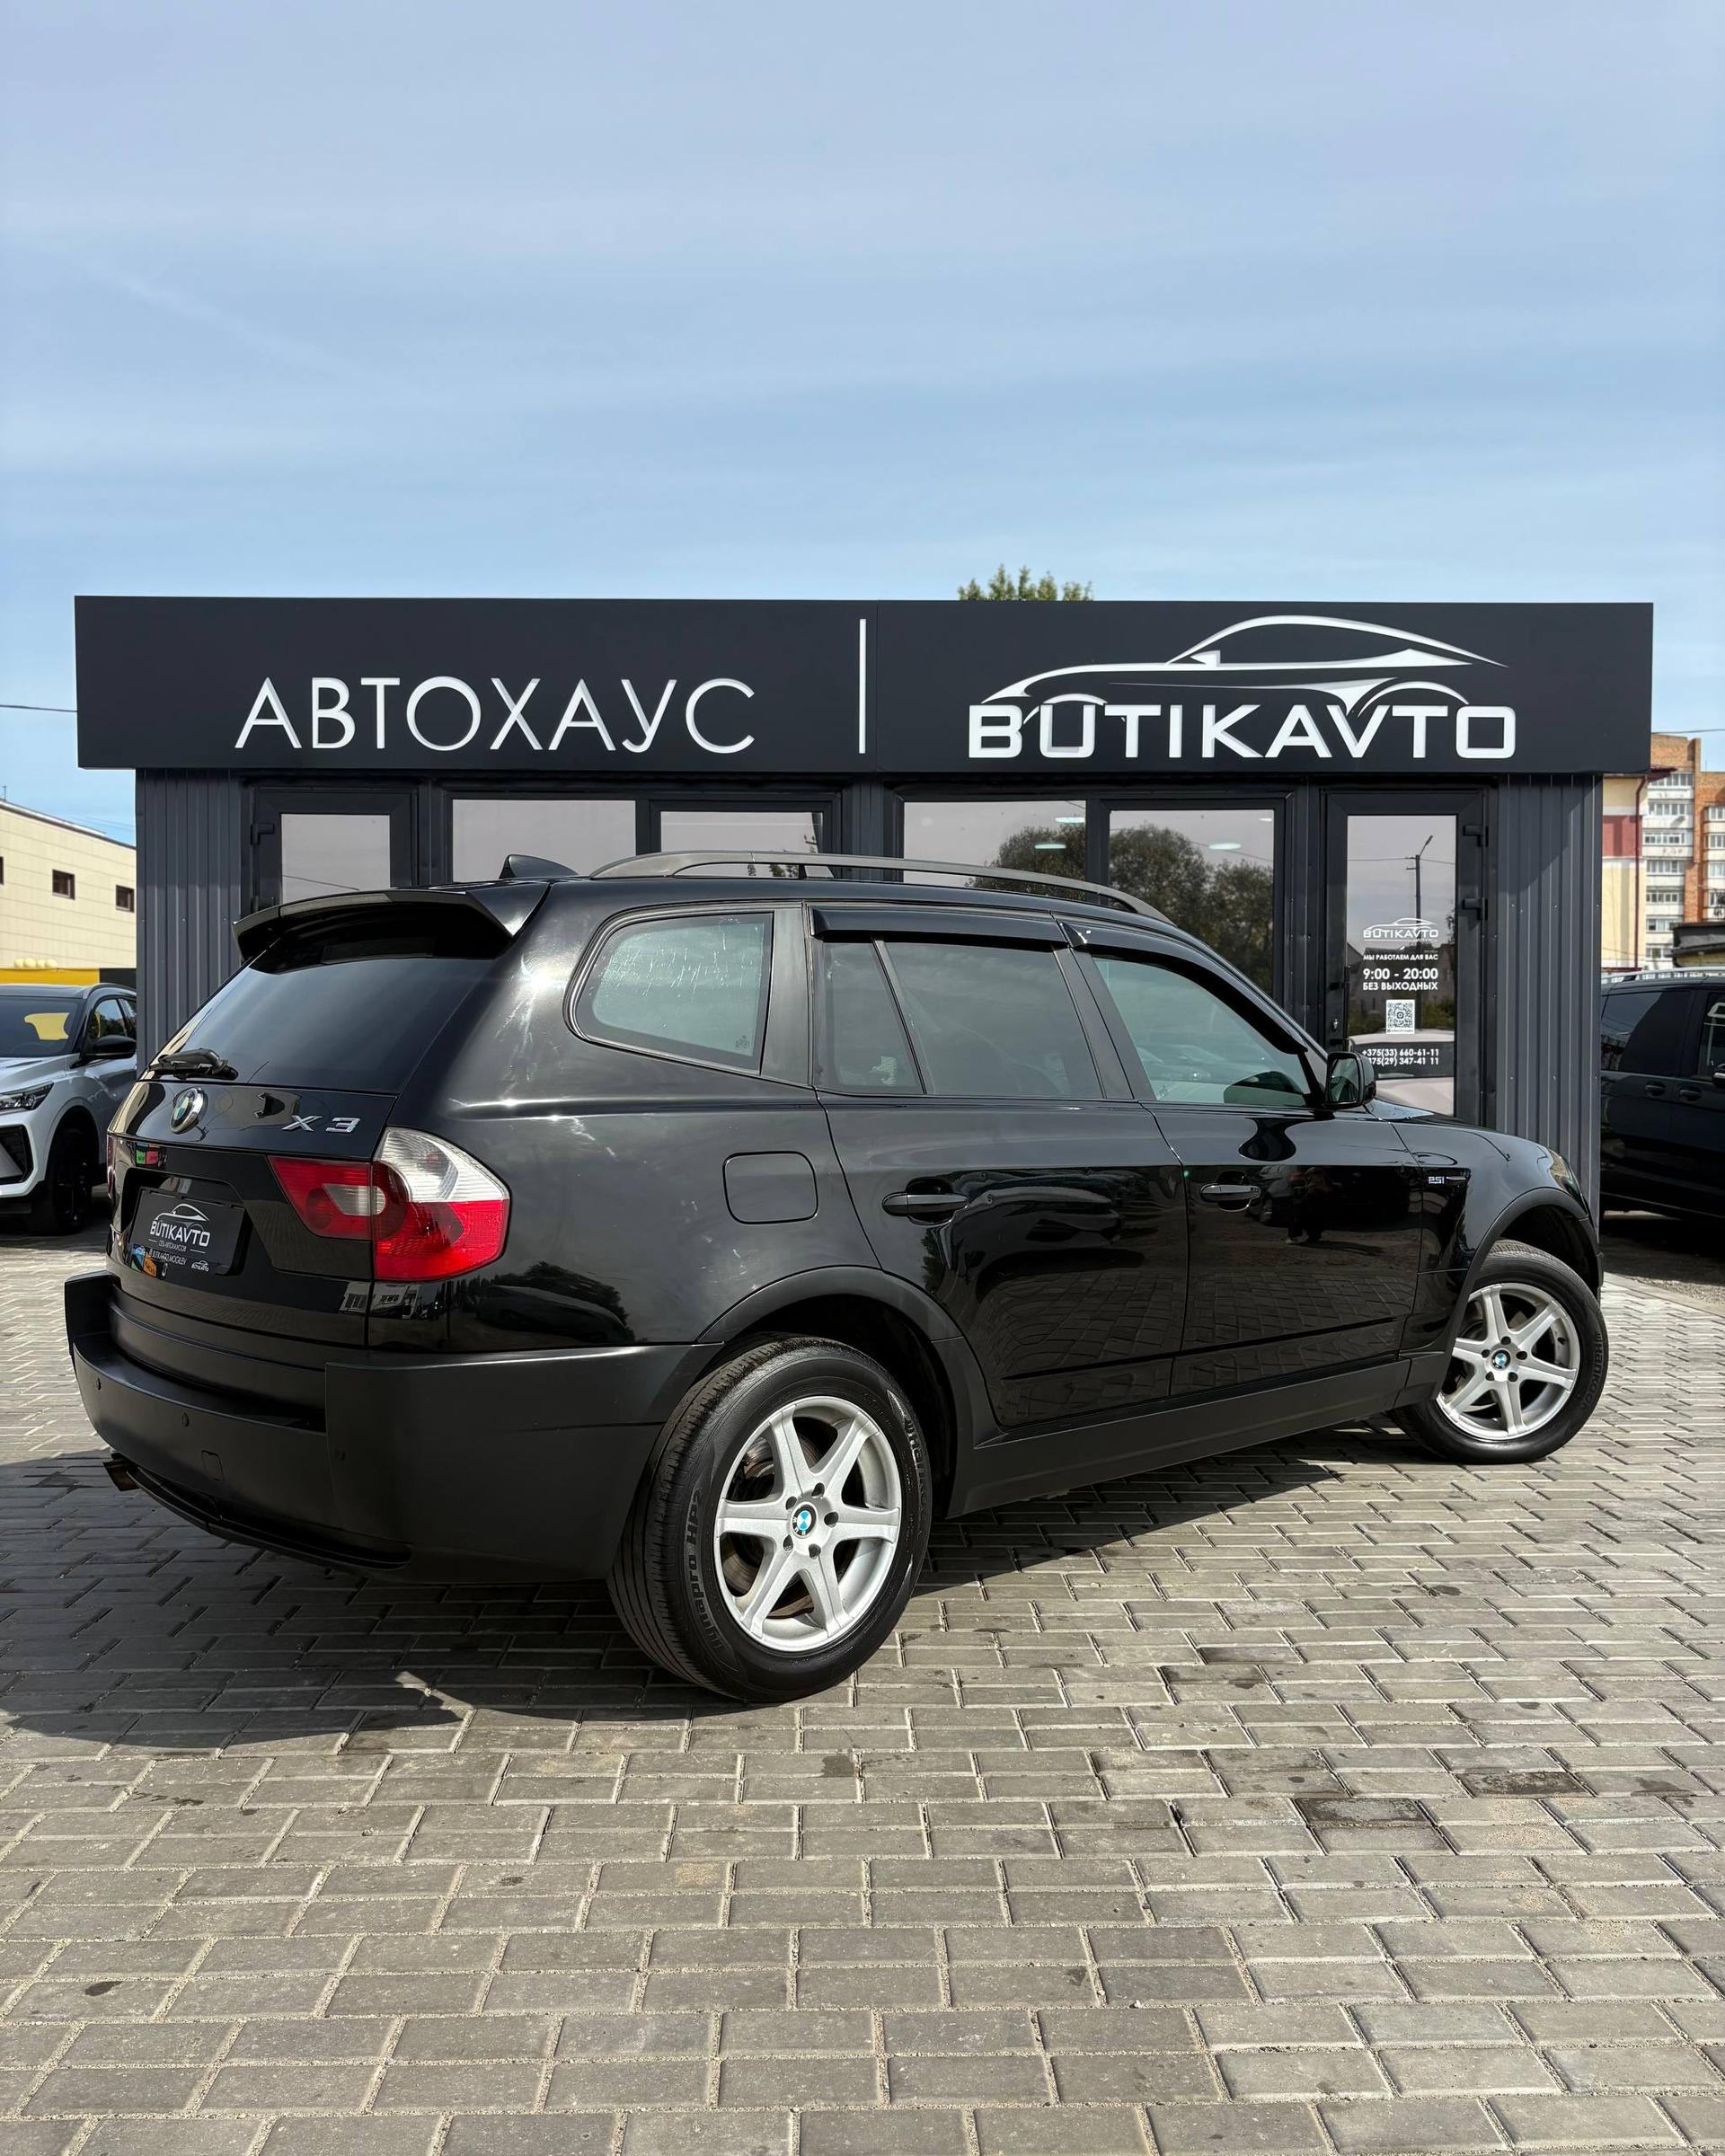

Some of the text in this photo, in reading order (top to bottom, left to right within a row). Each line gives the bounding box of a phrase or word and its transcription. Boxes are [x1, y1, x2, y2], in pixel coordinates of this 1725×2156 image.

[234, 676, 755, 754] АВТОХАУС
[968, 704, 1517, 759] BUTIKAVTO
[1363, 929, 1438, 938] BUTIKAVTO
[1363, 968, 1390, 980] 9:00
[1403, 968, 1438, 980] 20:00
[1363, 982, 1438, 991] БЕЗ ВЫХОДНЫХ
[1362, 1048, 1439, 1057] +375(33) 660-61-11
[150, 1221, 210, 1247] BUTIKAVTO
